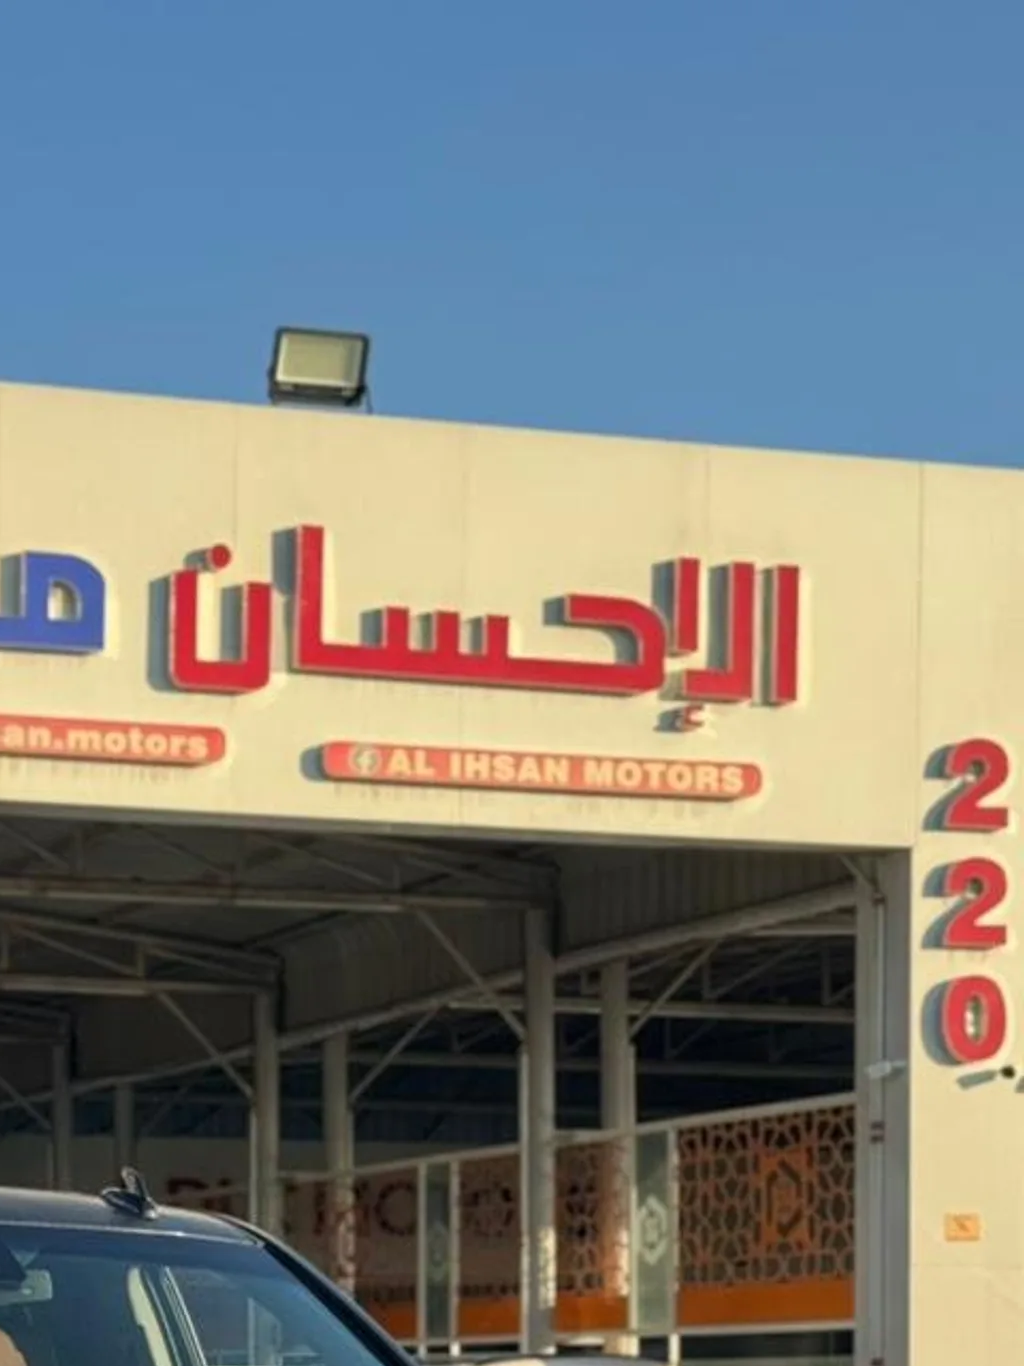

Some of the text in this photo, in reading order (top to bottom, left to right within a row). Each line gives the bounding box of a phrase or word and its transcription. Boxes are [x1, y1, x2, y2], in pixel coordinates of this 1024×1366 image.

[169, 524, 800, 732] الإحسان
[386, 748, 744, 793] AL IHSAN MOTORS
